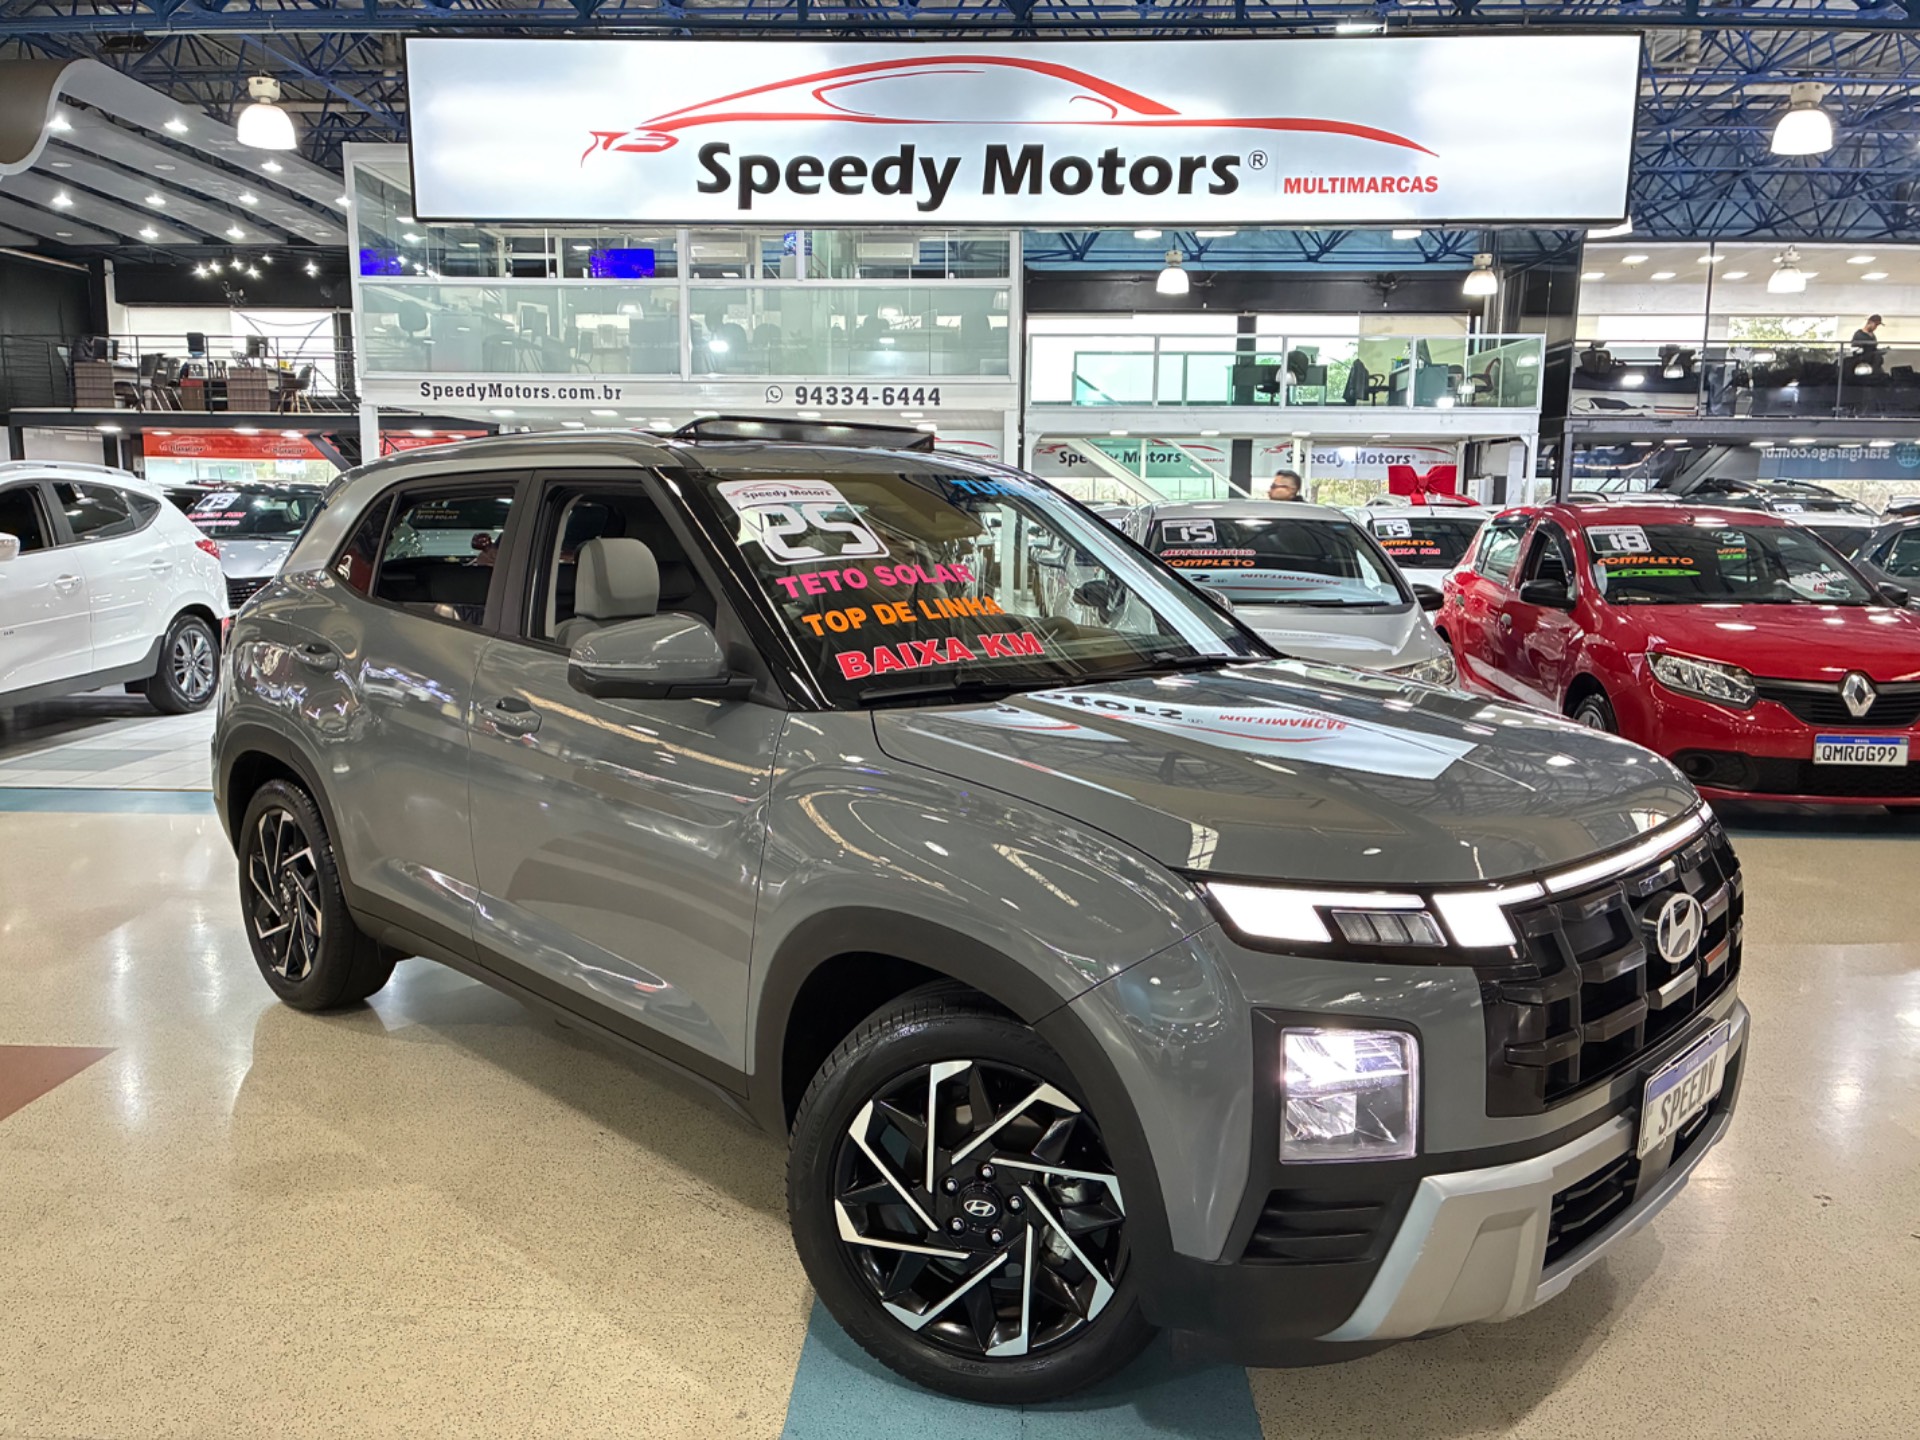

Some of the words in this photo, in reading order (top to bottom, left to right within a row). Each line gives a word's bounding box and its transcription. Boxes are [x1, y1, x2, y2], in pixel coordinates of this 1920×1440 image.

[696, 141, 962, 212] Speedy
[982, 144, 1241, 196] Motors
[1283, 175, 1439, 195] MULTIMARCAS
[420, 382, 622, 401] SpeedyMotors.com.br
[795, 386, 941, 406] 94334-6444
[745, 502, 879, 559] 25
[1608, 533, 1648, 552] 18
[1597, 556, 1694, 566] COMPLETO
[776, 567, 868, 599] TETO
[873, 564, 976, 586] SOLAR
[802, 607, 867, 636] TOP
[872, 601, 918, 625] DE
[922, 596, 1006, 620] LINHA
[836, 637, 976, 680] BAIXA
[978, 631, 1045, 659] KM
[1658, 1053, 1718, 1135] SPEEDY
